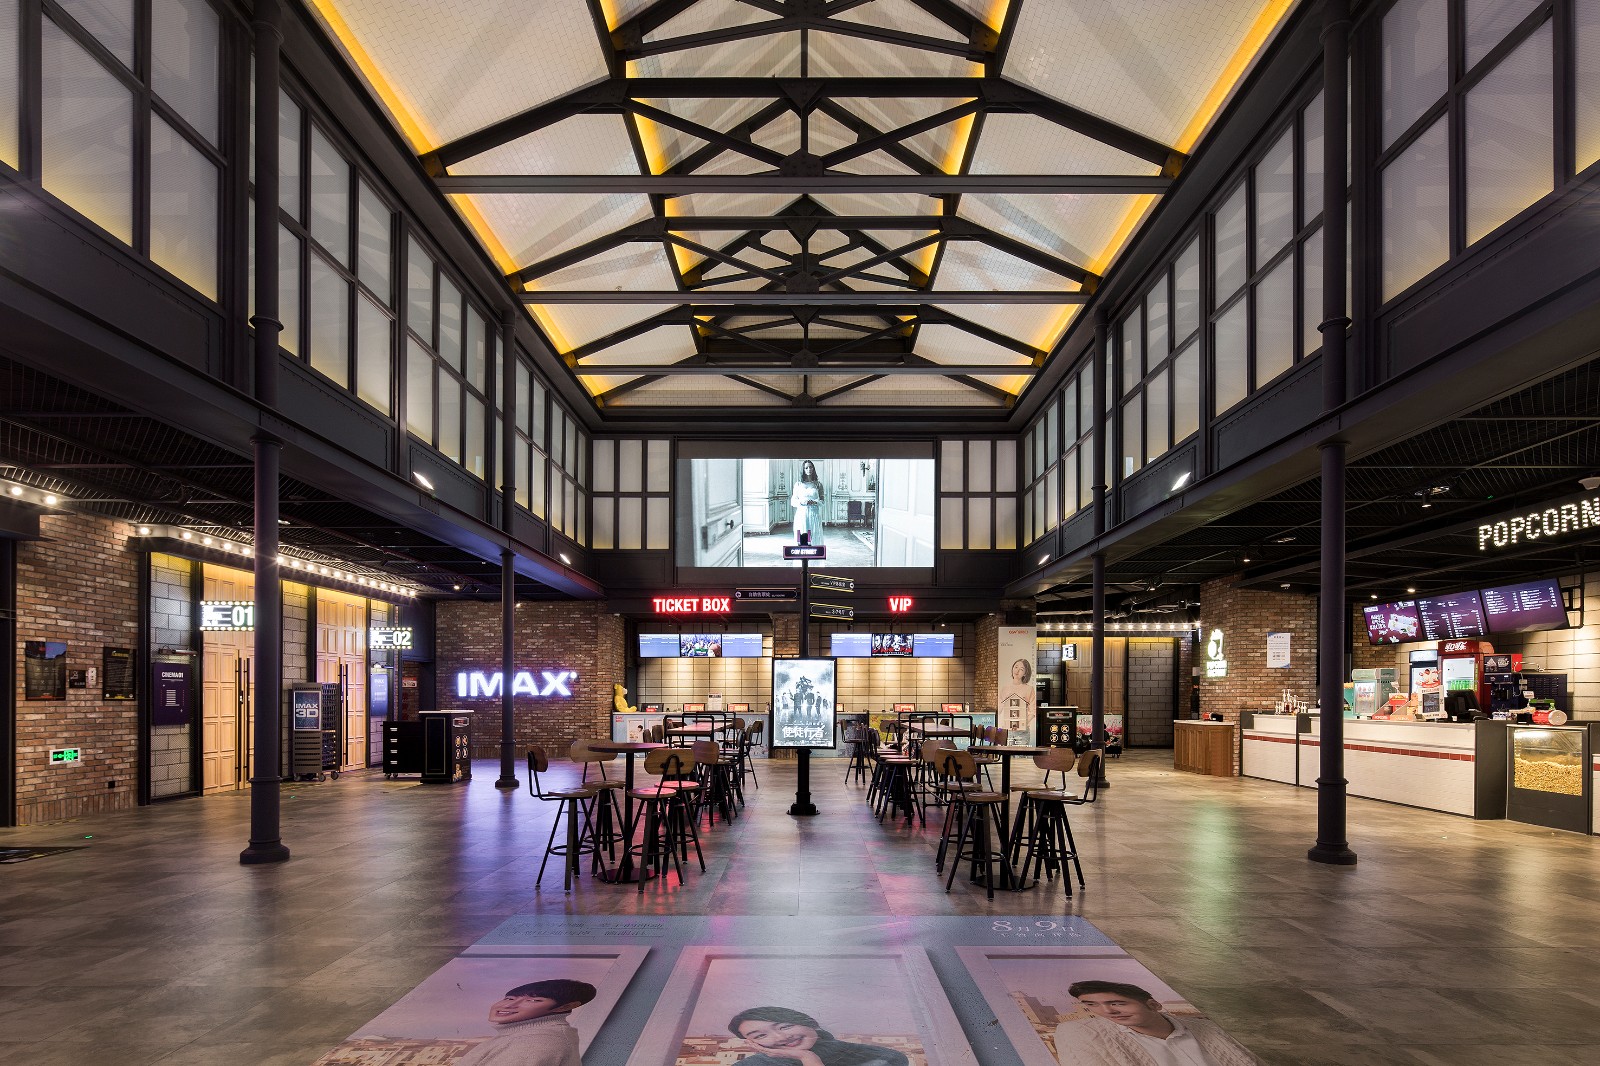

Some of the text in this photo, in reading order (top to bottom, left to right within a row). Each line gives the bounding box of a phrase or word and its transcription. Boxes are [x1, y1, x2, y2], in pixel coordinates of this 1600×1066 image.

[1478, 497, 1600, 551] POPCORN
[653, 597, 730, 613] TICKET BOX
[889, 597, 913, 612] VIP
[231, 606, 254, 627] 01
[392, 630, 412, 646] 02
[457, 671, 572, 697] IMAX
[295, 708, 319, 718] 3D
[782, 725, 825, 740] 使徒行者
